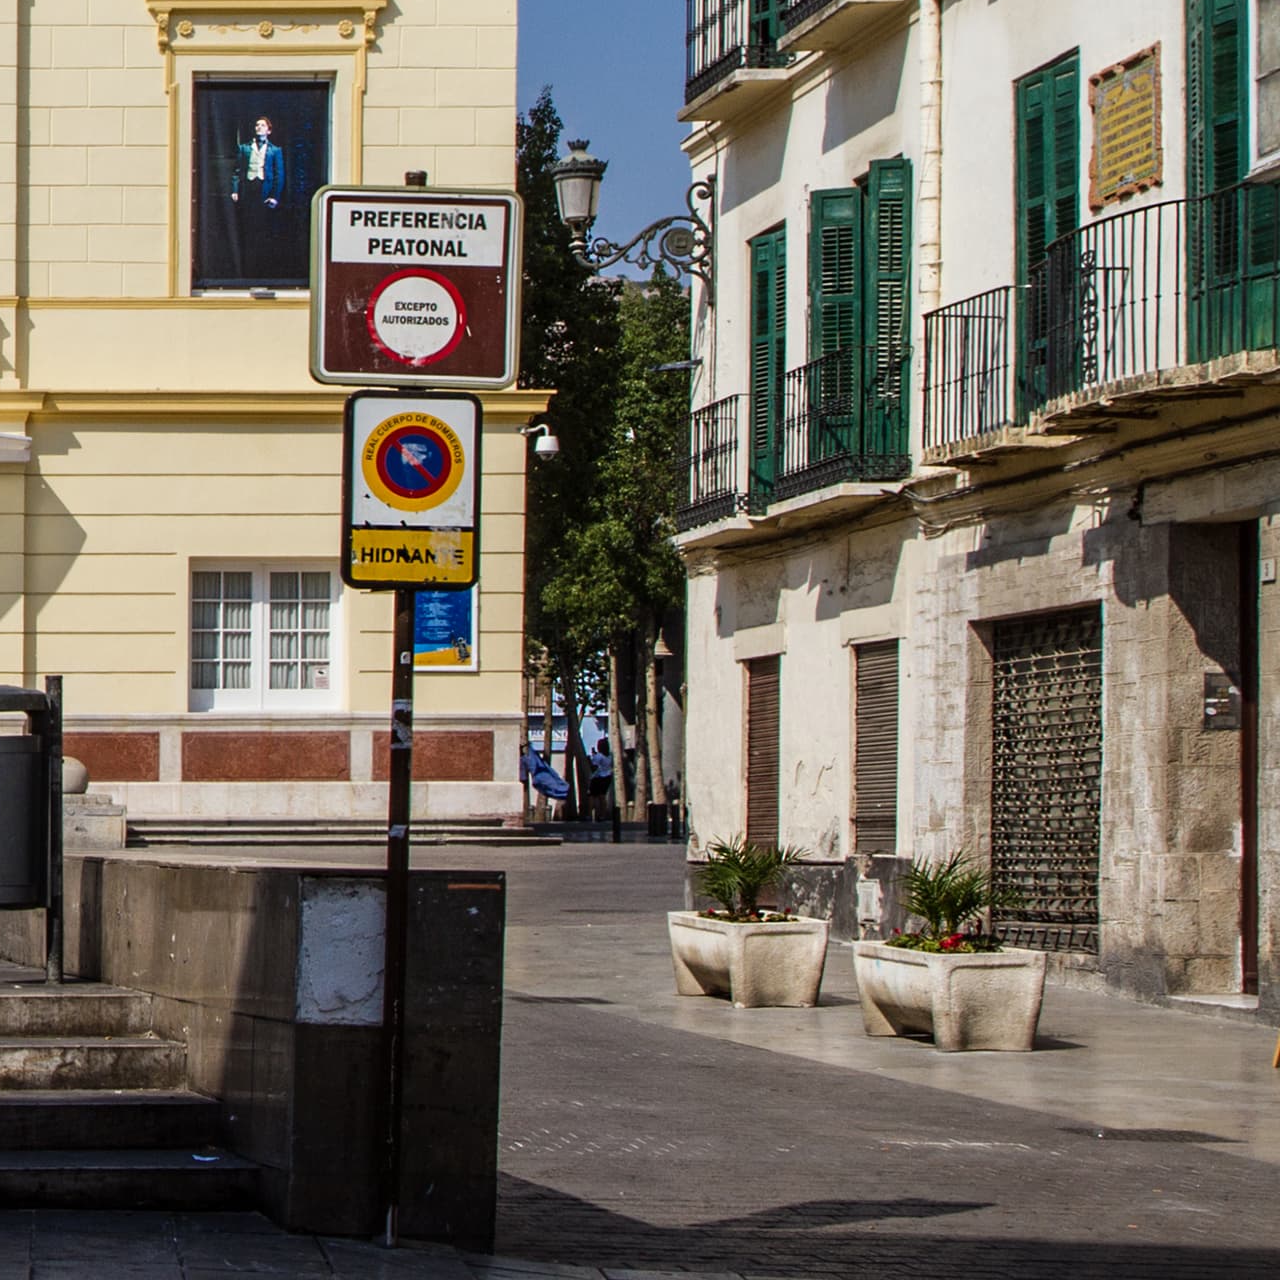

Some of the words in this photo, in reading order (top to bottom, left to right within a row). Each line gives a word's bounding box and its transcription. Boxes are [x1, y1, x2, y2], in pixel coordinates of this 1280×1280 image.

[350, 210, 487, 230] PREFERENCIA
[367, 237, 468, 257] PEATONAL
[394, 301, 437, 312] EXCEPTO
[382, 315, 449, 326] AUTORIZADOS
[365, 434, 379, 461] REAL
[377, 414, 413, 436] CUERPO
[415, 414, 428, 424] DE
[429, 419, 462, 464] BOMBEROS
[361, 547, 464, 565] HIDRANE
